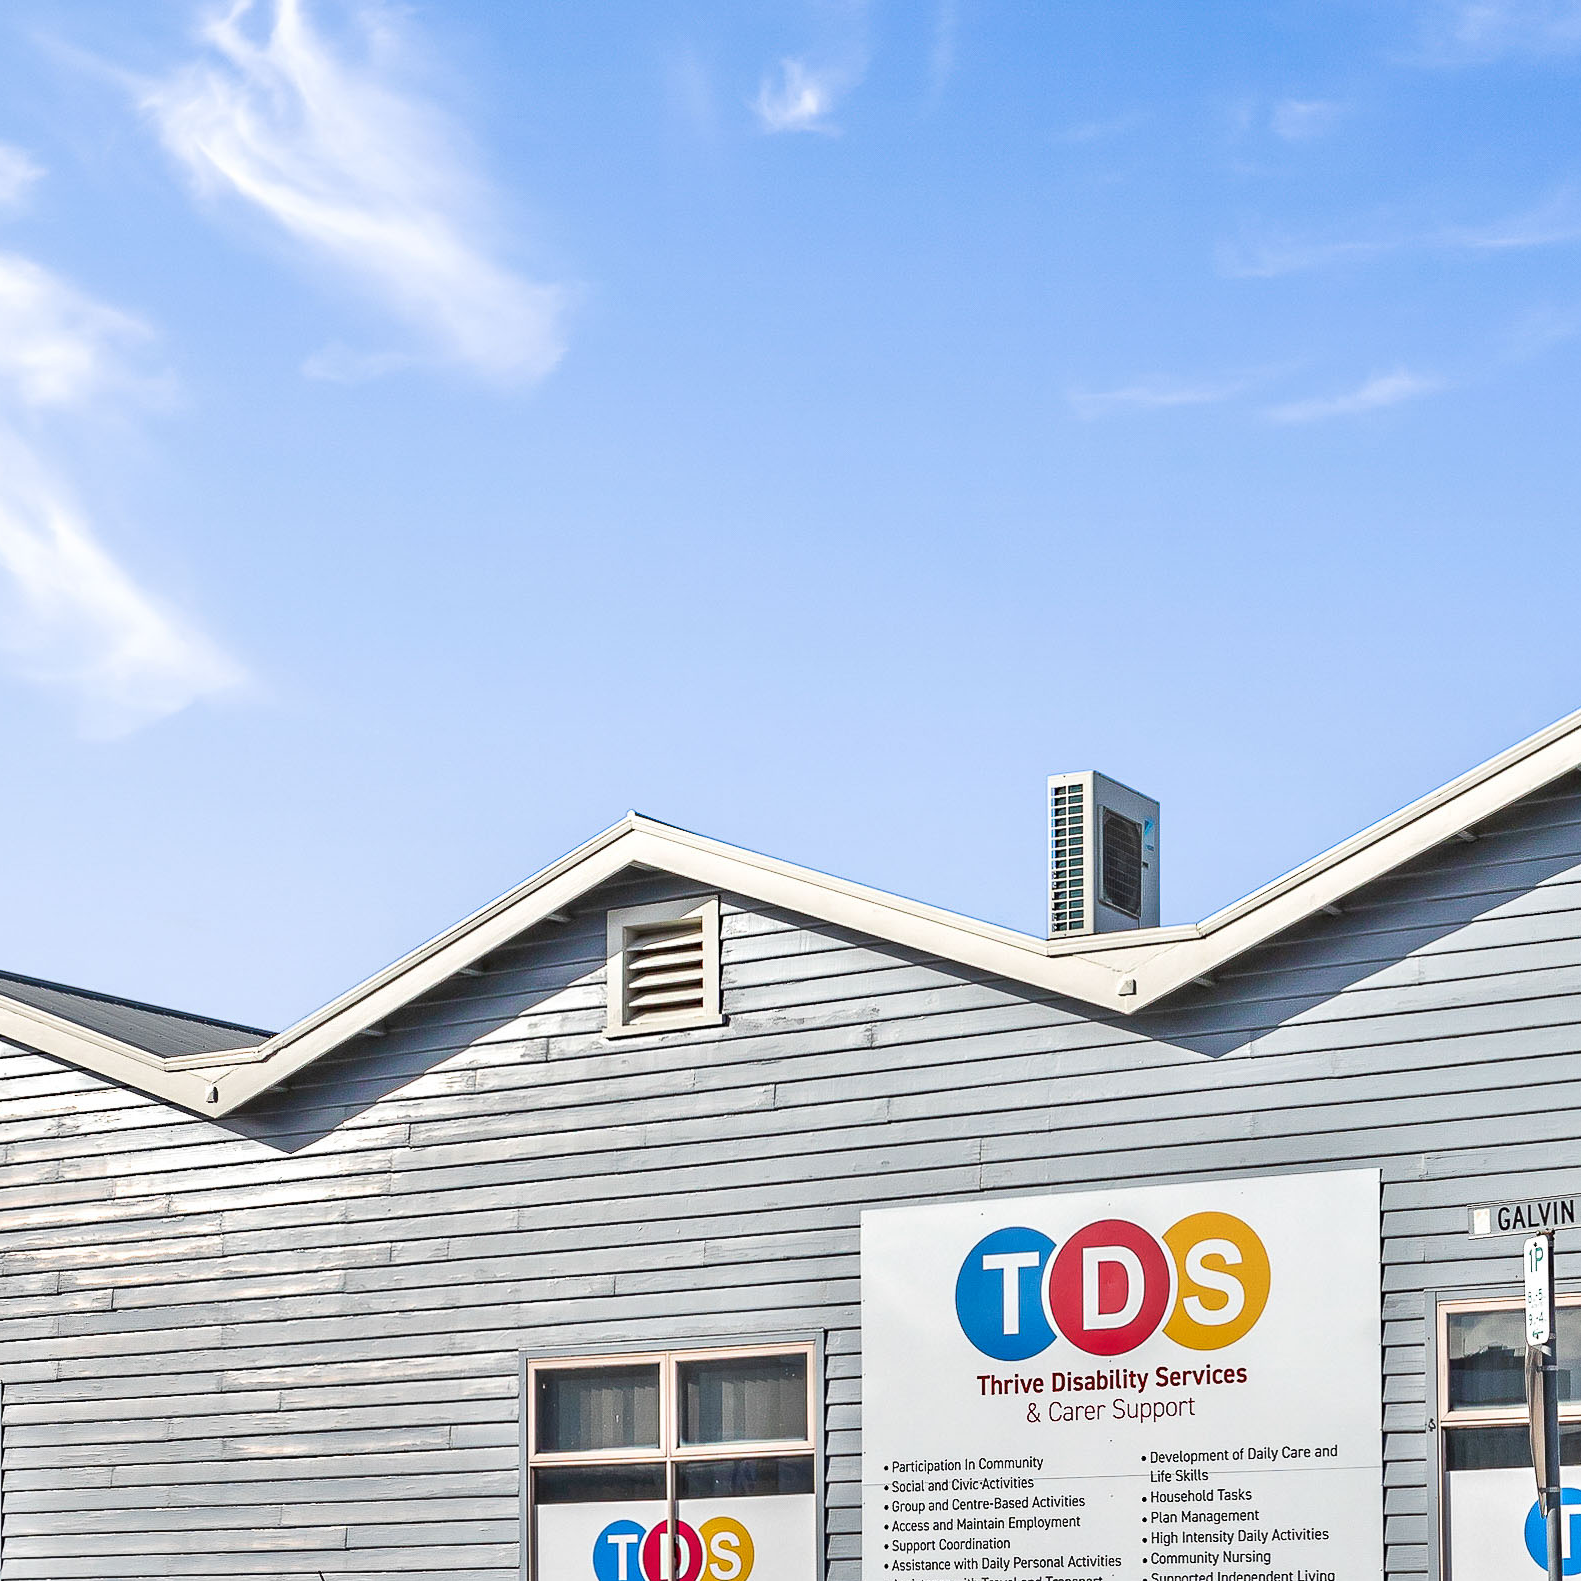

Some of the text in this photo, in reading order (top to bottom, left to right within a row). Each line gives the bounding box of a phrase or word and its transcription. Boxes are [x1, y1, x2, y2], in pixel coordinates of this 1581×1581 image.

[1498, 1200, 1574, 1230] GALVIN
[1529, 1247, 1543, 1272] 1P
[982, 1237, 1245, 1336] TDS
[977, 1364, 1247, 1395] Thrive Disability Services
[1027, 1398, 1195, 1423] & Carer Support
[1151, 1444, 1337, 1465] Development of Daily Care and
[892, 1457, 1043, 1474] Participation In Community
[892, 1477, 1034, 1492] Social and Civic Activities
[1151, 1469, 1209, 1483] Life Skills
[1151, 1488, 1252, 1503] Household Tasks
[892, 1495, 1085, 1514] Group and Centre-Based Activities
[892, 1516, 1081, 1532] Access and Maintain Employment
[1151, 1510, 1259, 1524] Plan Management
[1151, 1528, 1329, 1546] High Intensity Daily Activities
[892, 1538, 1010, 1554] Support Coordination
[608, 1531, 742, 1581] TDS
[892, 1555, 1121, 1571] Assistance with Daily Personal Activities
[1151, 1550, 1271, 1566] Community Nursing
